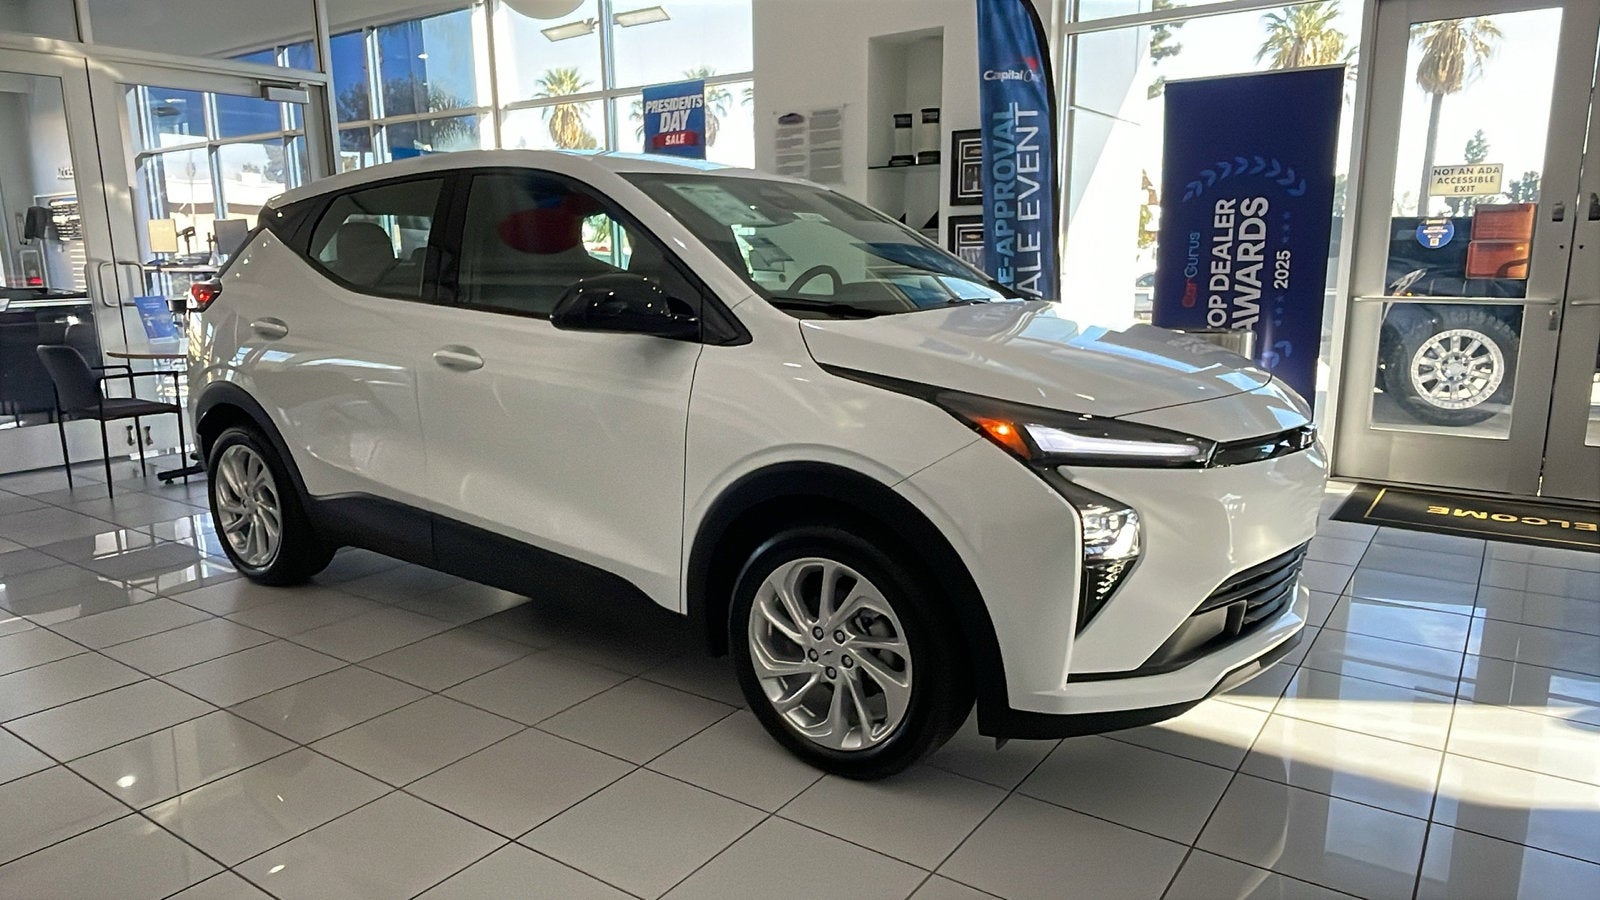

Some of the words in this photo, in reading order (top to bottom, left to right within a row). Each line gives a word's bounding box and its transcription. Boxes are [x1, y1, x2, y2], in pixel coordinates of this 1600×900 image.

[983, 69, 1024, 83] Capital
[645, 94, 703, 114] PRESIDENTS
[659, 109, 691, 133] DAY
[665, 133, 686, 146] SALE
[1014, 102, 1041, 221] EVENT
[1433, 168, 1455, 176] NOT
[1458, 167, 1474, 175] AN
[1477, 166, 1500, 174] ADA
[1437, 176, 1495, 184] ACCESSIBLE
[1454, 185, 1476, 193] EXIT
[992, 102, 1016, 291] E-APPROVAL
[1209, 197, 1237, 291] DEALER
[1016, 231, 1043, 299] ALE
[1231, 196, 1269, 330] AWARDS
[1273, 249, 1291, 289] 2025
[1207, 294, 1228, 329] OP
[1426, 504, 1599, 532] ELCOME
